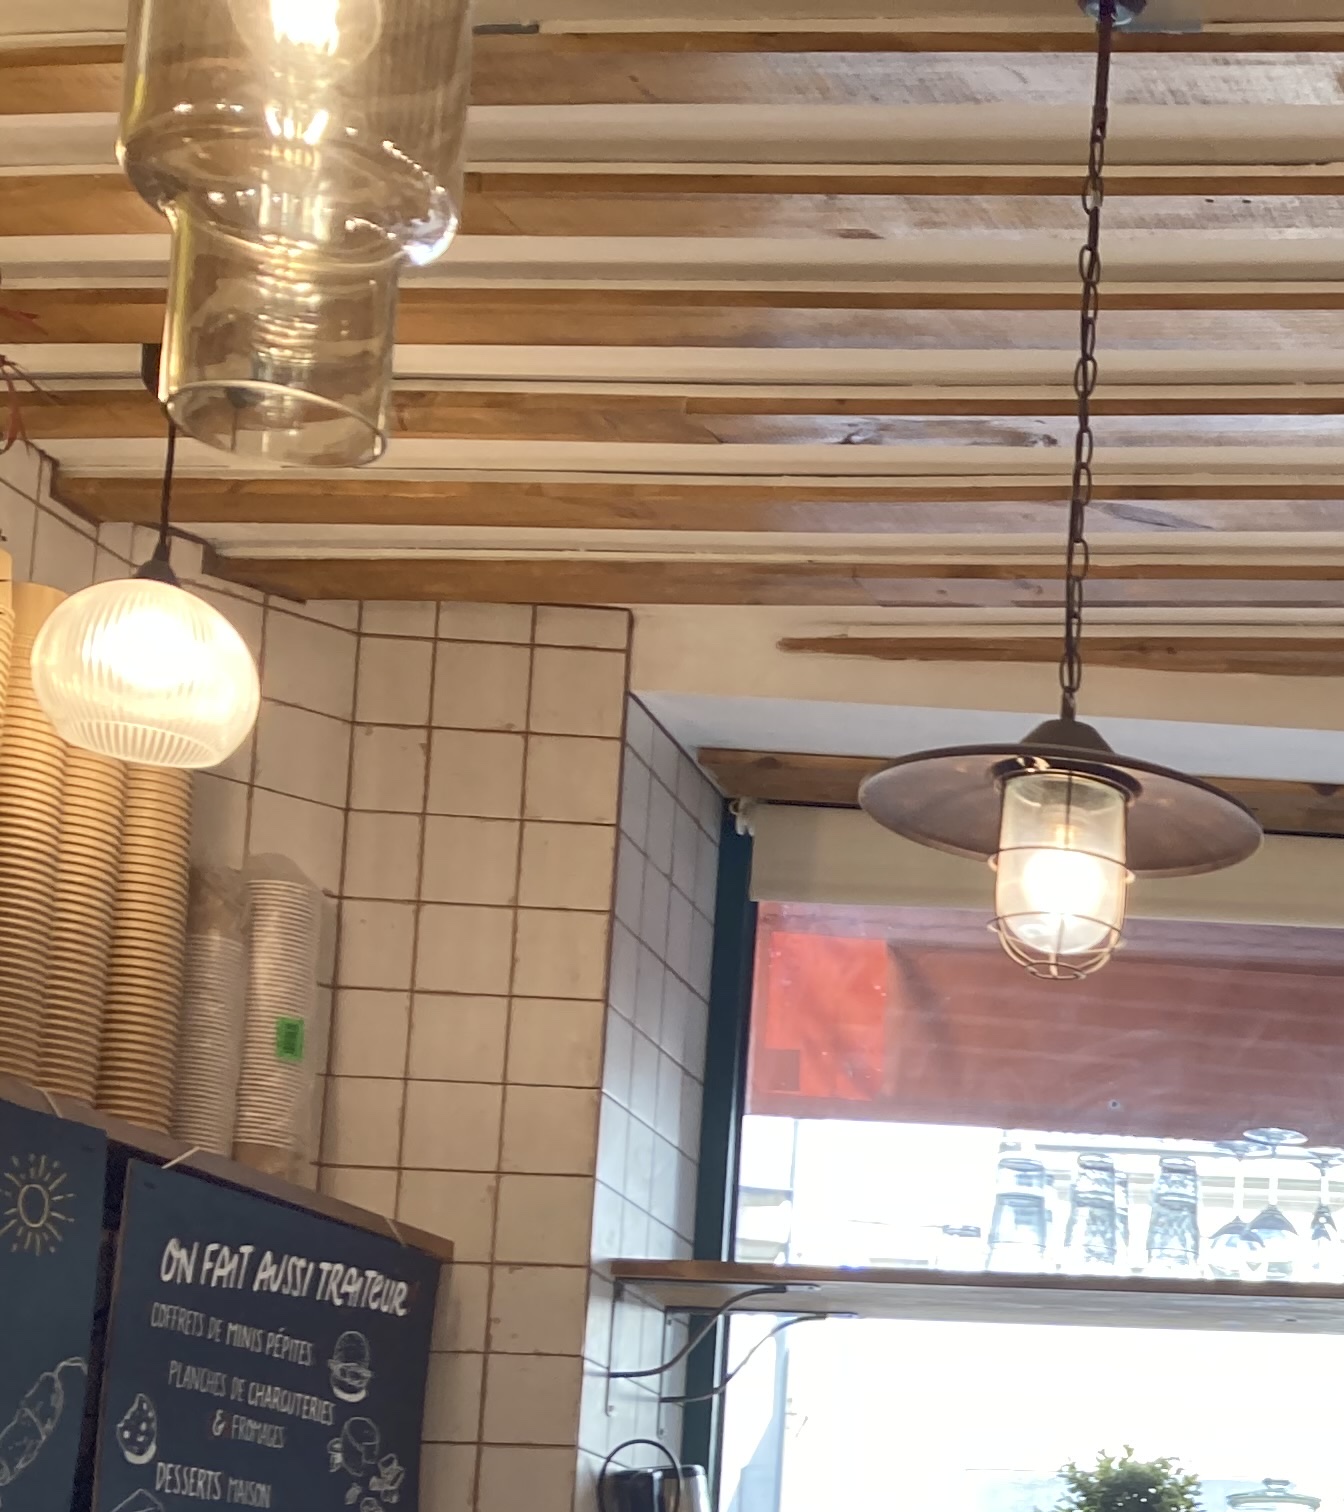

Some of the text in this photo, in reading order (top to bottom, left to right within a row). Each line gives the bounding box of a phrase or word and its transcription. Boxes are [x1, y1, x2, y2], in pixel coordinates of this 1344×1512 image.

[160, 1238, 199, 1284] ON
[201, 1243, 255, 1289] FAIT
[253, 1250, 314, 1297] AUSSI
[151, 1302, 206, 1337] COFFRETS
[208, 1317, 223, 1342] DE
[226, 1323, 264, 1353] MINIS
[168, 1360, 227, 1397] PLANCHES
[248, 1382, 336, 1426] CHARCUTERIES
[212, 1409, 225, 1436] &
[155, 1462, 271, 1508] DESSERTS MAISON
